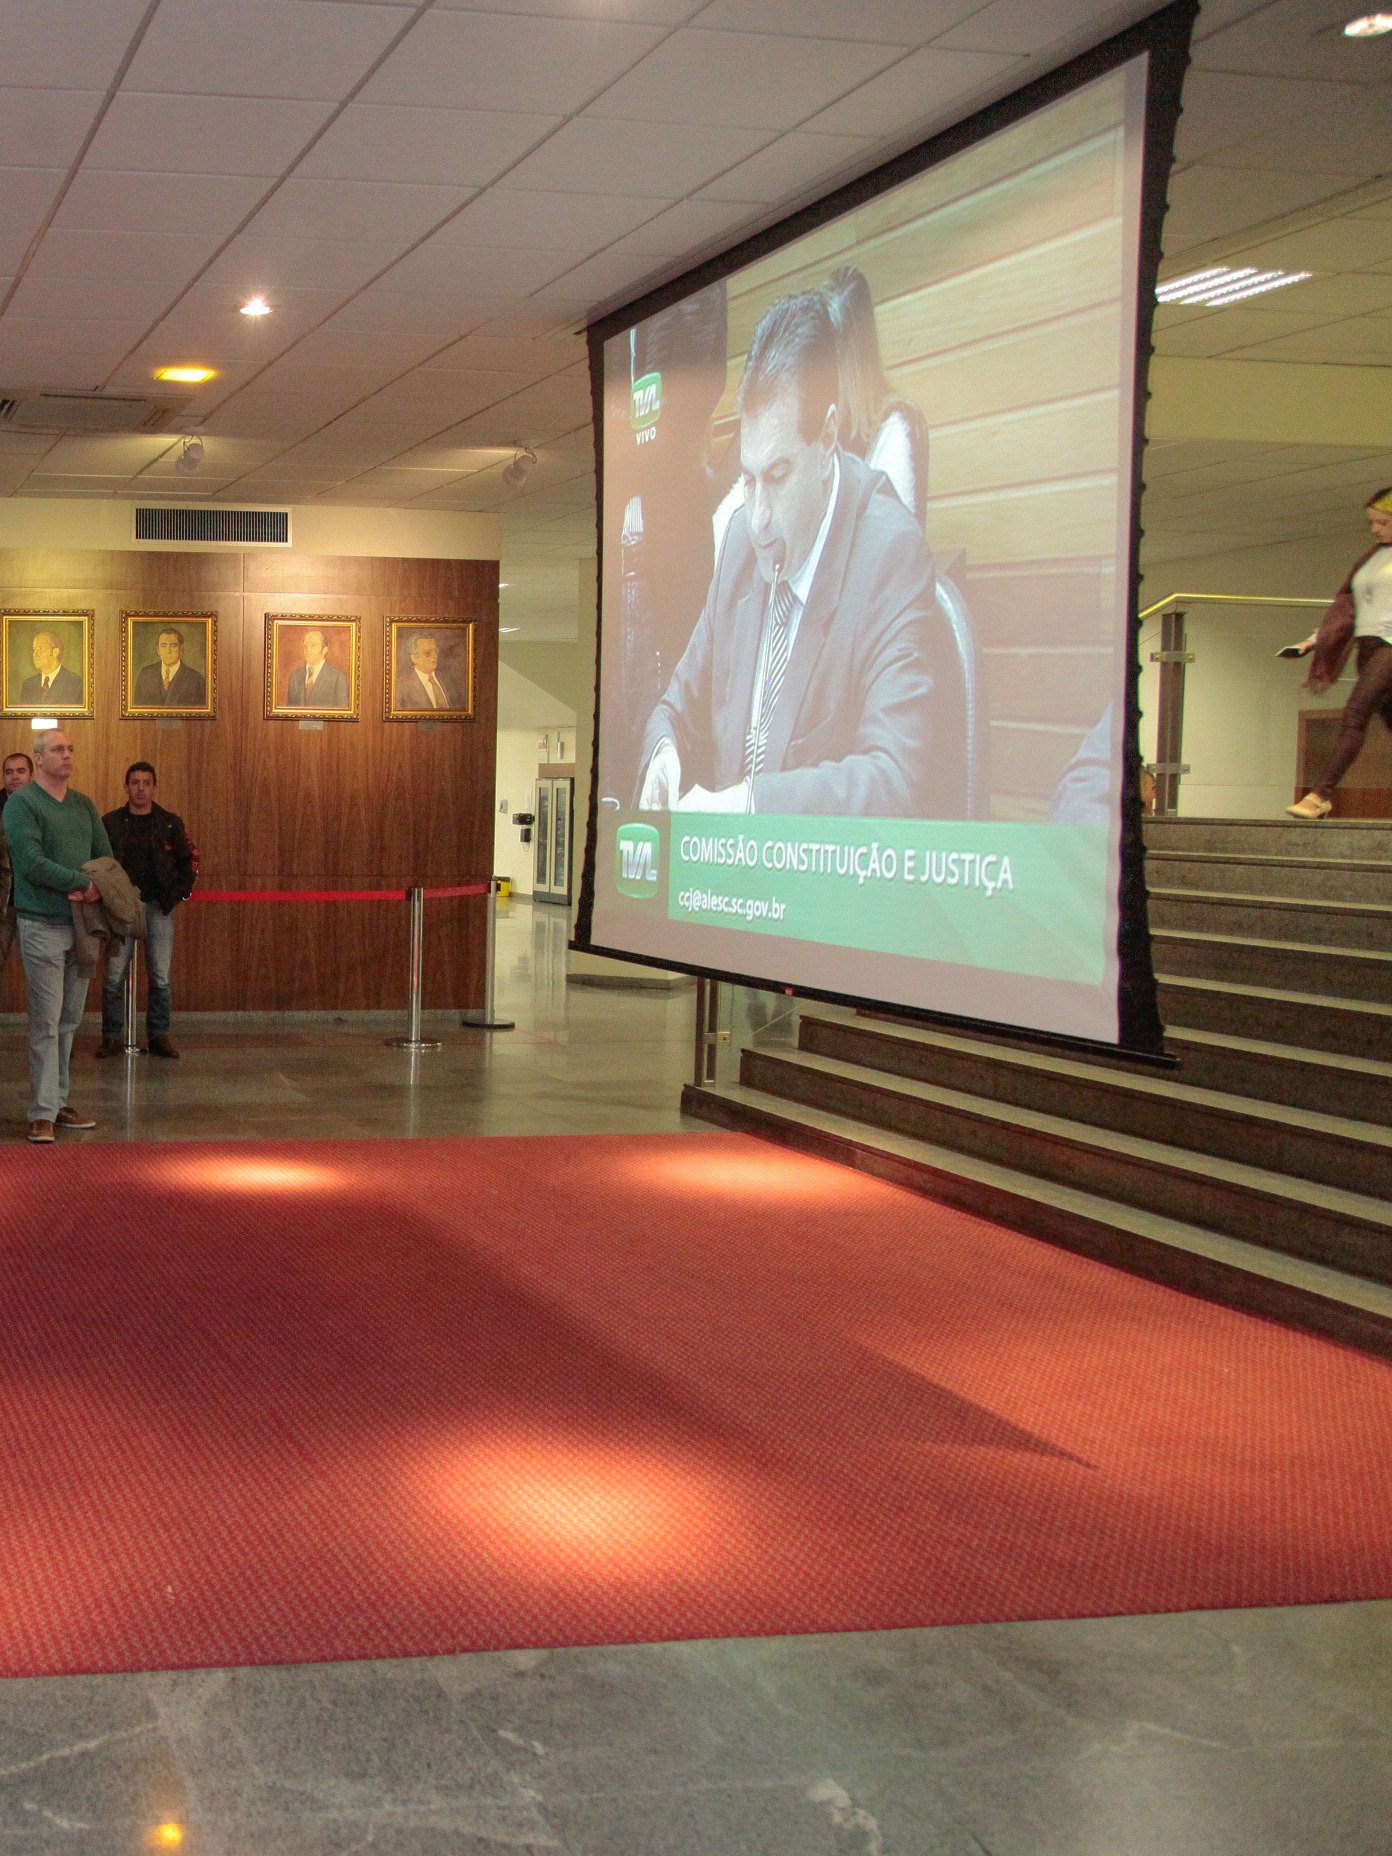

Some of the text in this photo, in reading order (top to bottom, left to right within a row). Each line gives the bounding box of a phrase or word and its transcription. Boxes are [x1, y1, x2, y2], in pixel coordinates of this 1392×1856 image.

[636, 426, 656, 446] VIVO
[680, 834, 1014, 897] COMISSÃO CONSTITUIÇÃO E JUSTIÇA
[678, 887, 786, 921] ccj@alesc.sc.gov.br
